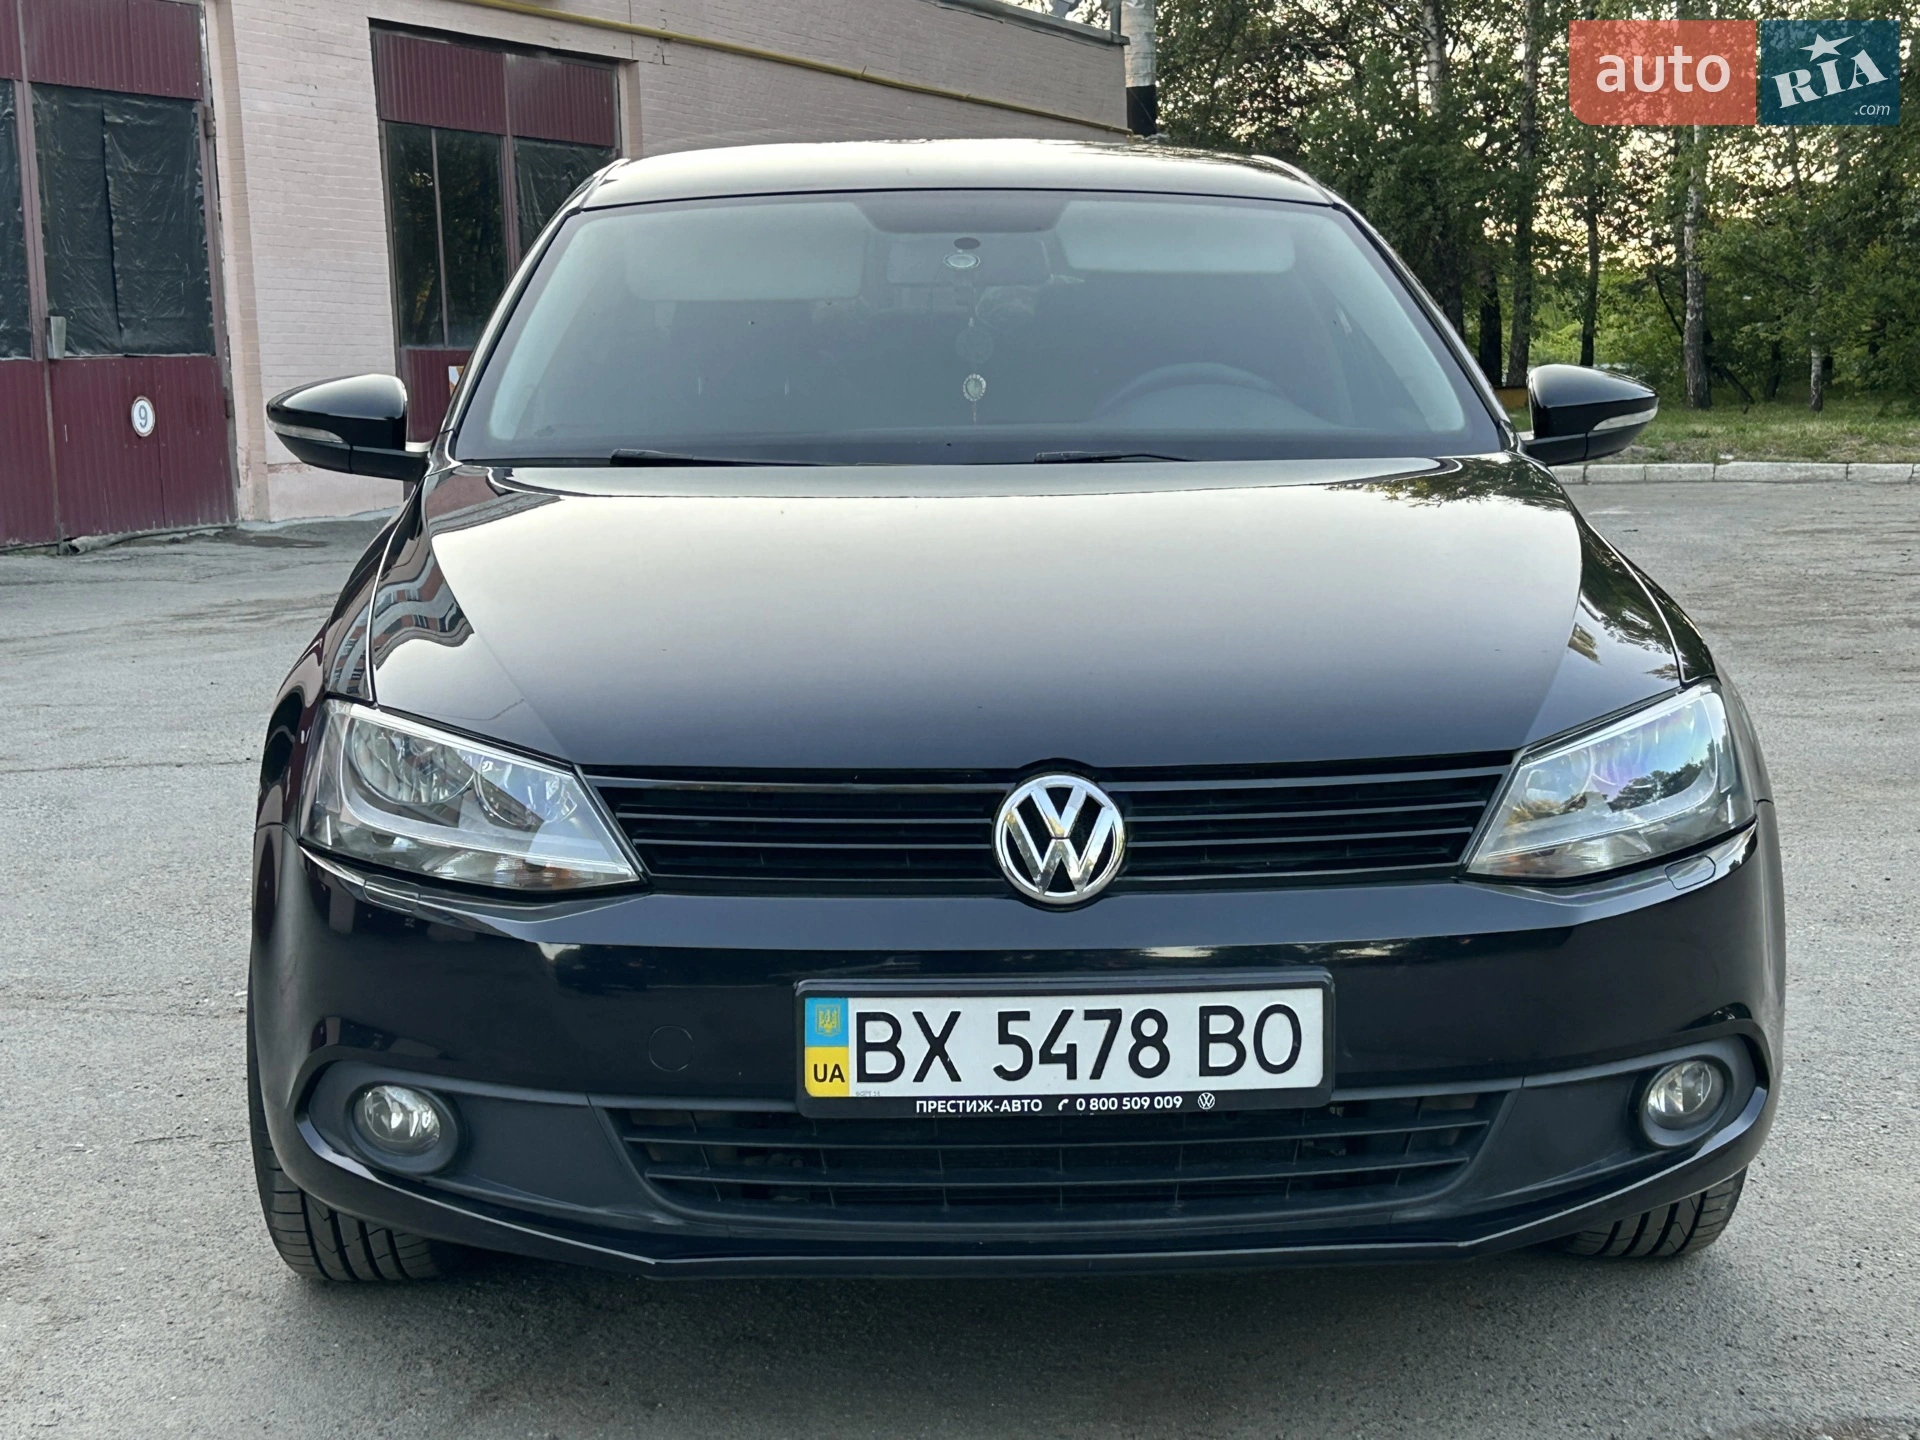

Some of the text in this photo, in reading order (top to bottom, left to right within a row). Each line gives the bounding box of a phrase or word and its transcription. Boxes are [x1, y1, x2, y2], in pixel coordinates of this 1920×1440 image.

[138, 404, 148, 429] 9
[856, 1003, 1302, 1083] BX 5478 BO
[813, 1064, 846, 1083] UA
[916, 1099, 1043, 1113] ПРЕСТИЖ-АВТО
[1076, 1098, 1086, 1111] 0
[1089, 1097, 1119, 1111] 800
[1121, 1096, 1151, 1110] 509
[1153, 1095, 1183, 1109] 009
